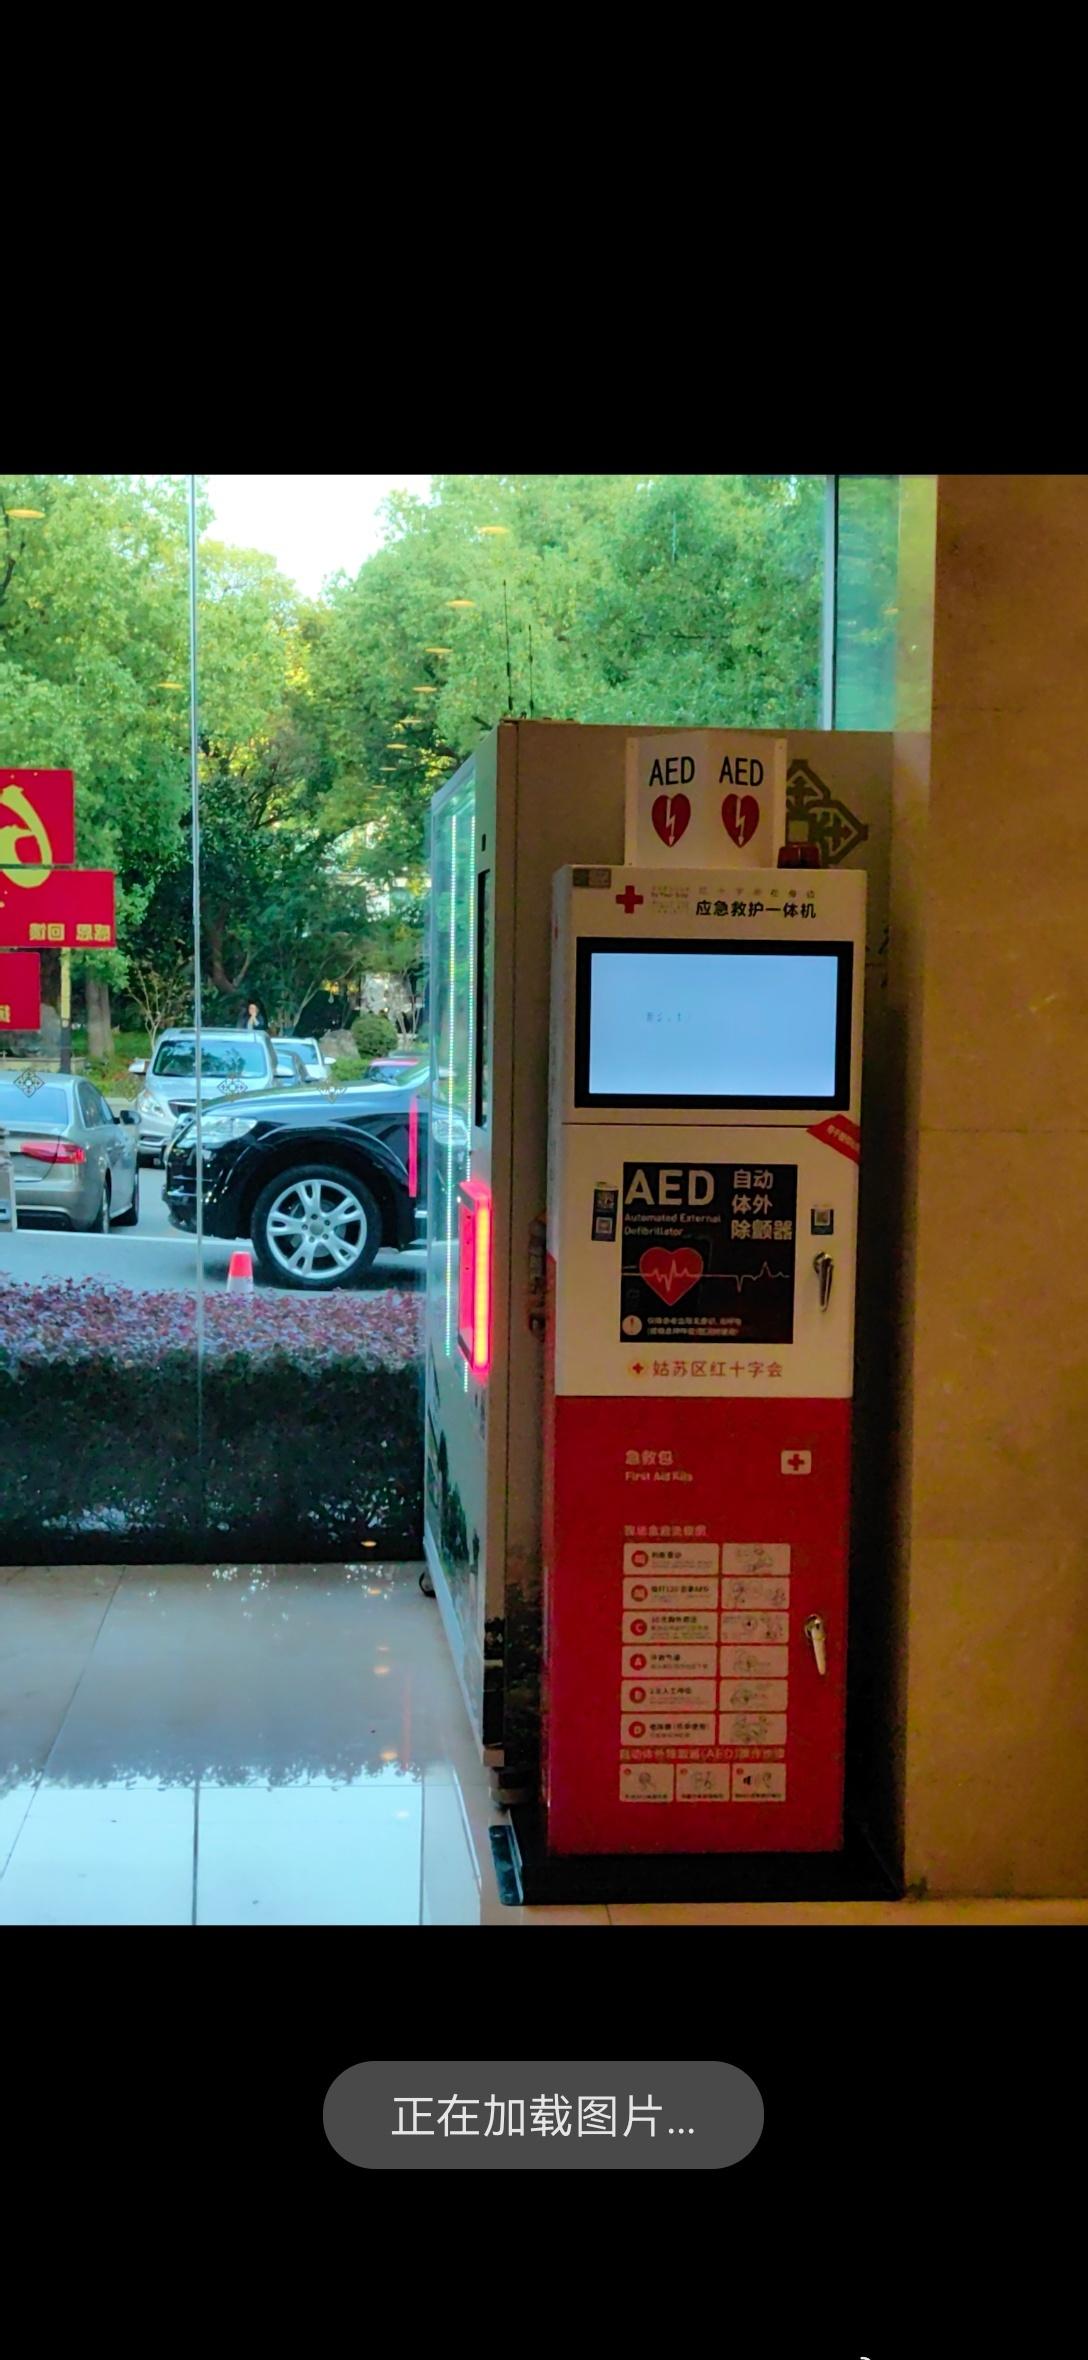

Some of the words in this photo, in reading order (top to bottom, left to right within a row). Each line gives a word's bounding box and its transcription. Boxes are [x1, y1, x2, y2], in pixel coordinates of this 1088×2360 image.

[649, 756, 695, 786] AED
[719, 756, 764, 786] AED
[695, 900, 817, 918] 应急救护一体机
[624, 1169, 715, 1206] AED
[732, 1169, 774, 1190] 自动
[731, 1194, 773, 1215] 体外
[624, 1213, 678, 1224] Automated
[679, 1213, 721, 1224] External
[624, 1226, 684, 1237] Defibrillator
[730, 1219, 793, 1240] 除颤器
[652, 1360, 784, 1378] 姑苏区红十字会
[625, 1450, 673, 1466] 急救包
